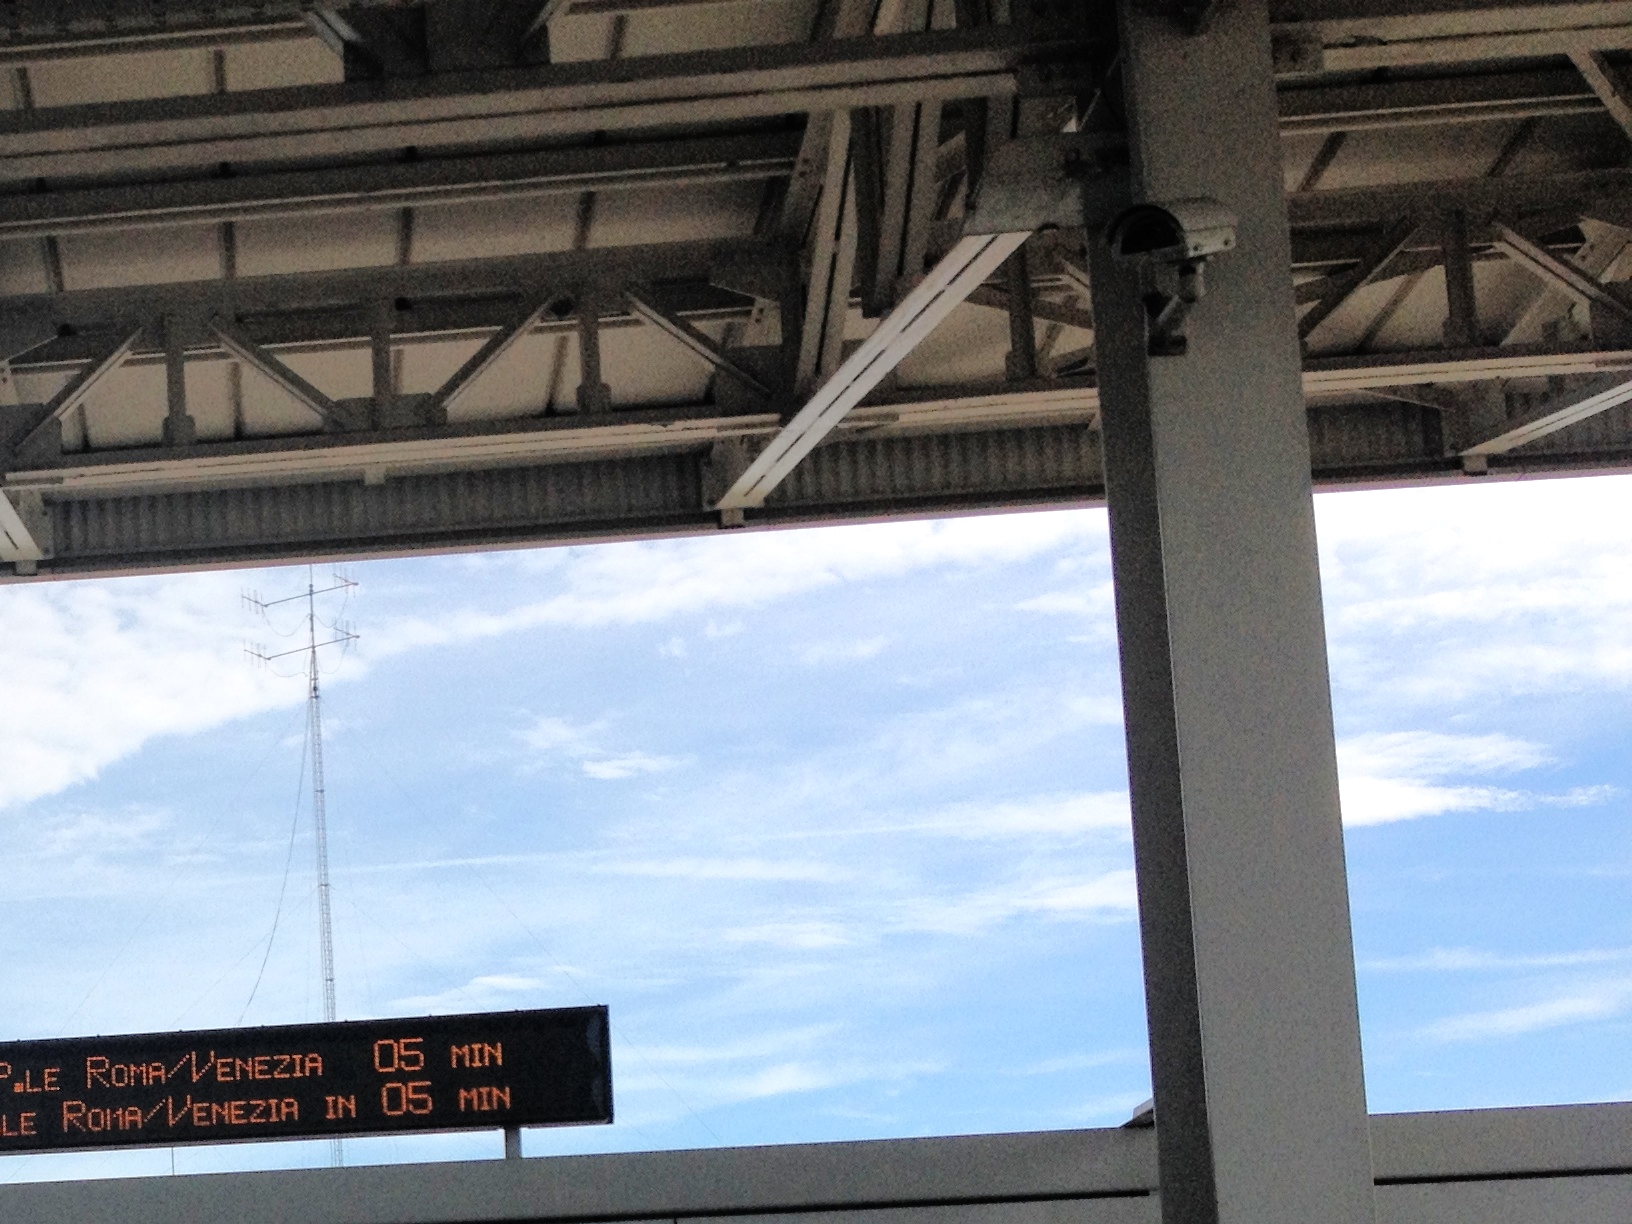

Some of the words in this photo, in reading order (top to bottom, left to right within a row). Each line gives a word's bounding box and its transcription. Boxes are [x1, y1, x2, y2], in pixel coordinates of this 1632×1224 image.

[373, 1037, 424, 1073] 05
[450, 1042, 503, 1069] MIN
[325, 1095, 356, 1120] IN
[381, 1081, 433, 1116] 05
[458, 1086, 511, 1112] MIN
